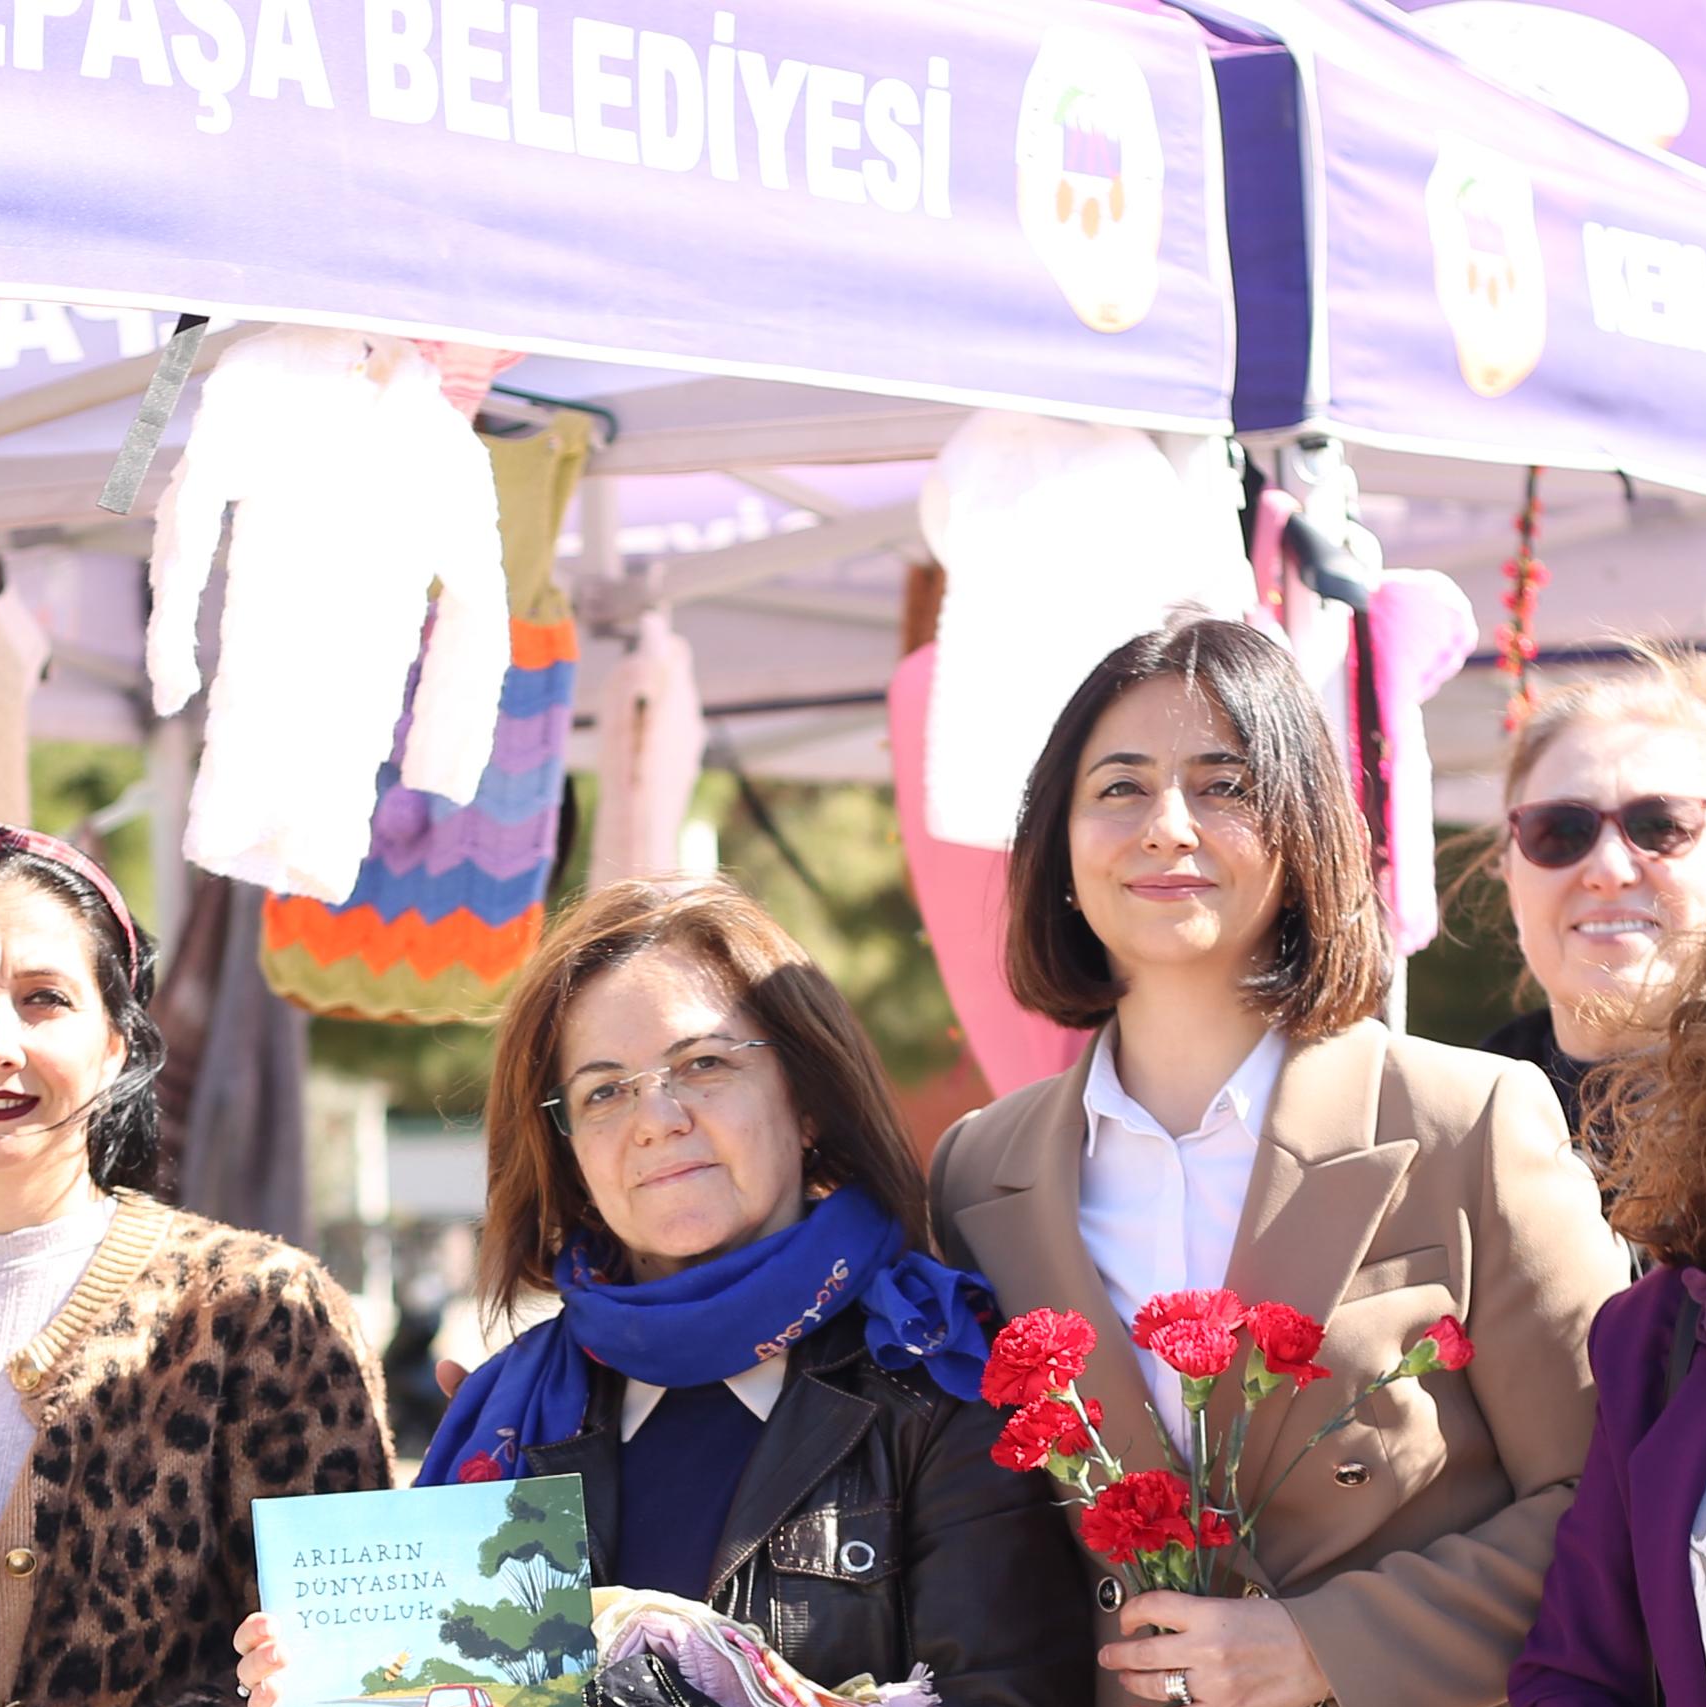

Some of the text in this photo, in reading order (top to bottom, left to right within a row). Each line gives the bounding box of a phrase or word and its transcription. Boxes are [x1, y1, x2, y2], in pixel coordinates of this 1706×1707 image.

[365, 0, 953, 219] BELEDİYESİ
[293, 1542, 423, 1567] ARILARIN
[295, 1571, 446, 1598] DÜNYASINA
[297, 1601, 433, 1628] YOLCULUK
